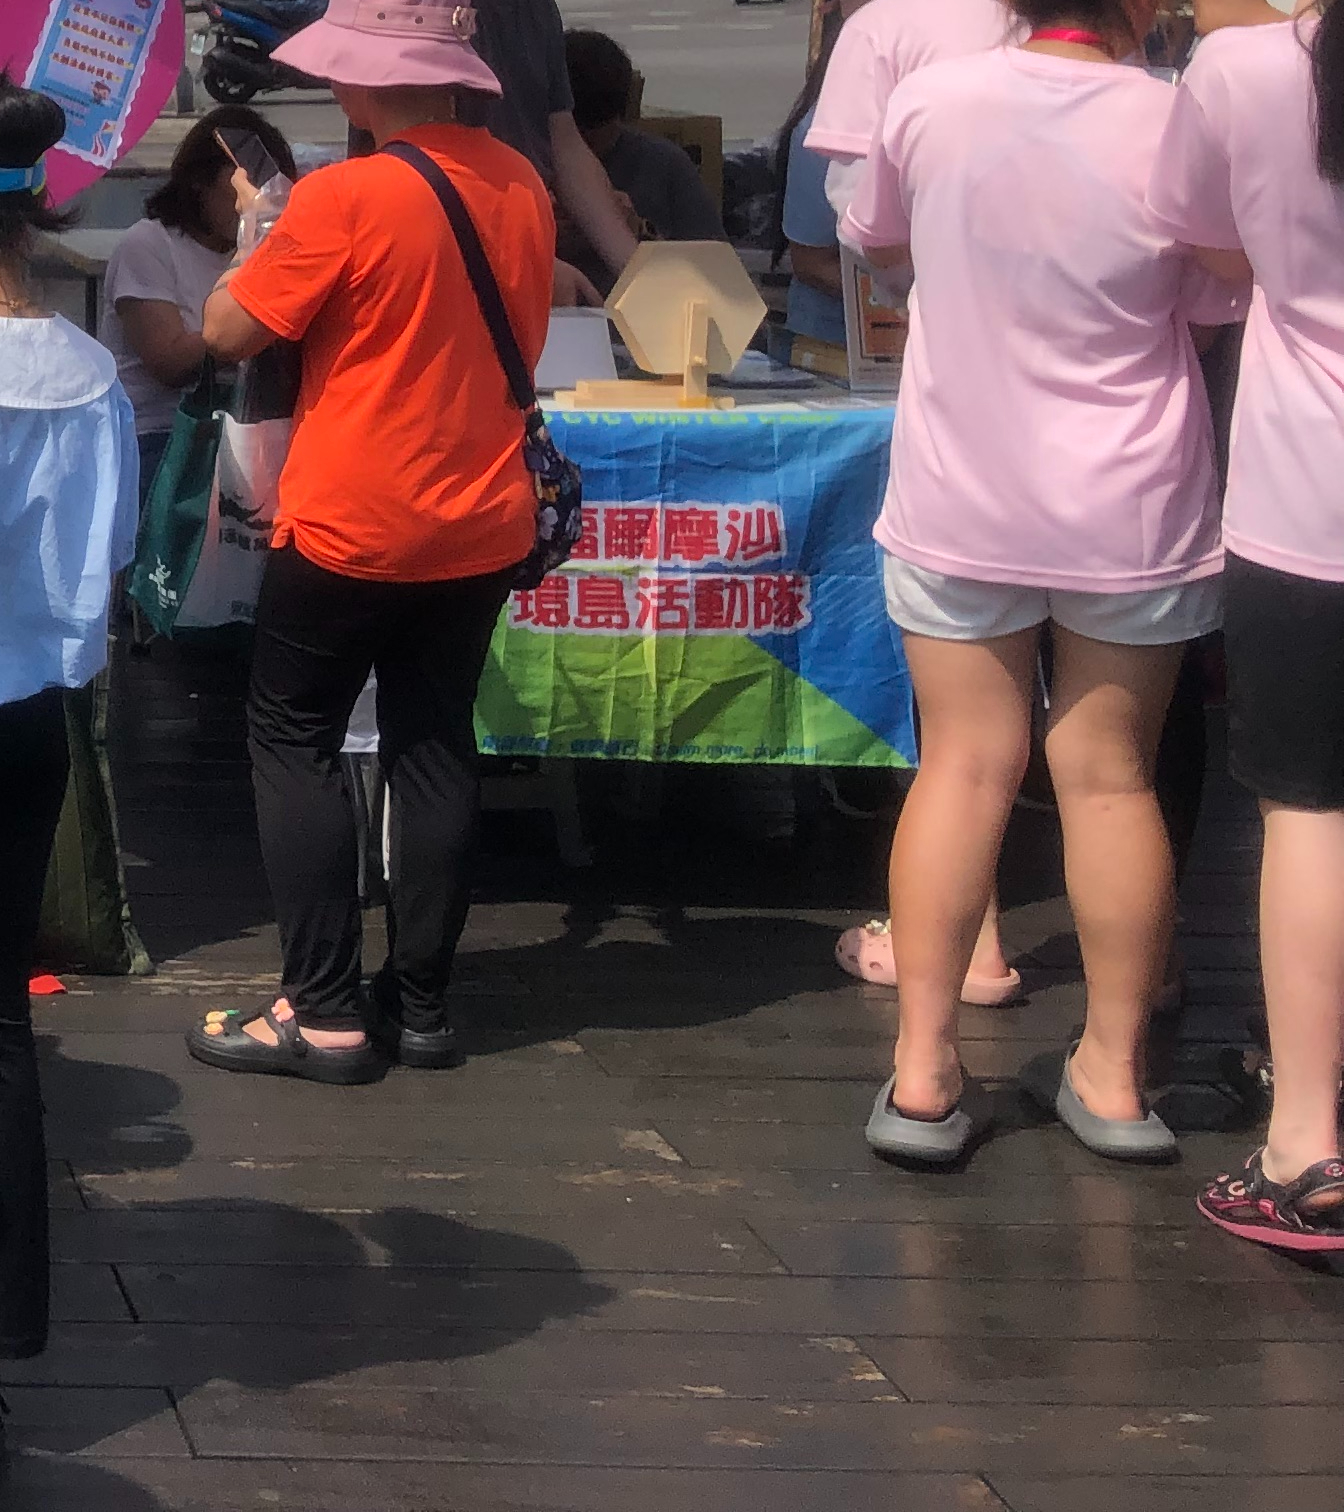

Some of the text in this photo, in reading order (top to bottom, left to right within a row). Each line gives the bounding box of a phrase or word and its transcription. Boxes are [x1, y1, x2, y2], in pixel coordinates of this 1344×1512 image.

[513, 573, 808, 631] 環島活動隊
